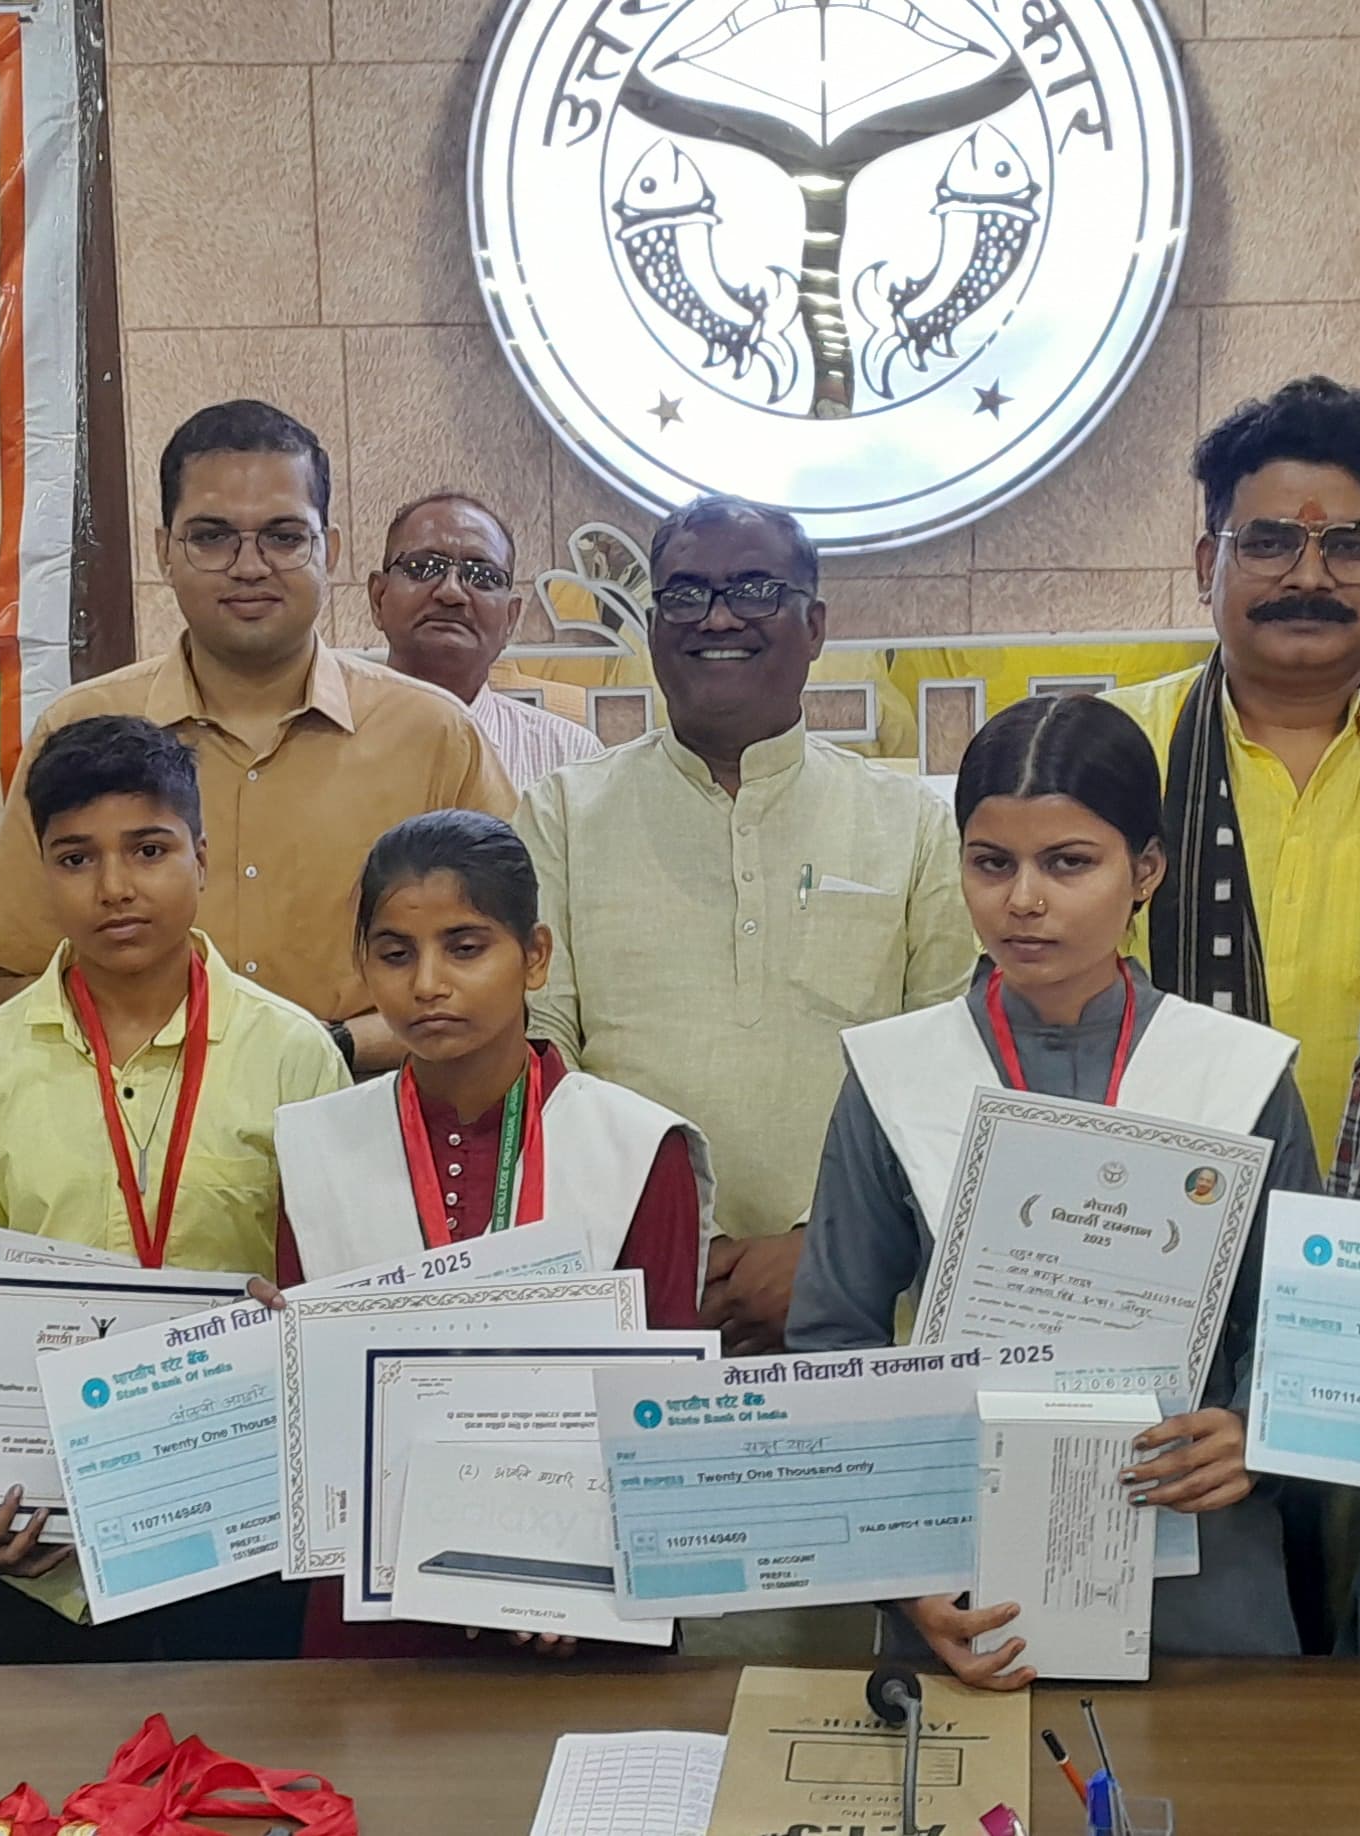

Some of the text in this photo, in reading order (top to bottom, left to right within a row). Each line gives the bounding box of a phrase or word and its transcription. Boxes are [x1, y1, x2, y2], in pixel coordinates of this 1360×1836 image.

[1082, 1233, 1112, 1247] 2025
[422, 1250, 473, 1280] 2025
[230, 1306, 273, 1332] विद्या
[793, 1357, 865, 1382] विद्यार्थी
[870, 1353, 945, 1377] सम्मान
[999, 1344, 1055, 1366] 2025
[116, 1384, 149, 1402] State
[152, 1375, 183, 1392] Bank
[203, 1361, 234, 1378] India
[667, 1414, 701, 1427] State
[703, 1412, 736, 1425] Bank
[756, 1409, 789, 1422] India
[152, 1435, 199, 1457] Twenty
[201, 1428, 229, 1444] One
[230, 1414, 278, 1436] Thousa
[458, 1463, 480, 1481] (2)
[696, 1470, 743, 1485] Twenty
[746, 1467, 774, 1481] One
[777, 1462, 843, 1479] Thousand
[846, 1460, 875, 1474] only
